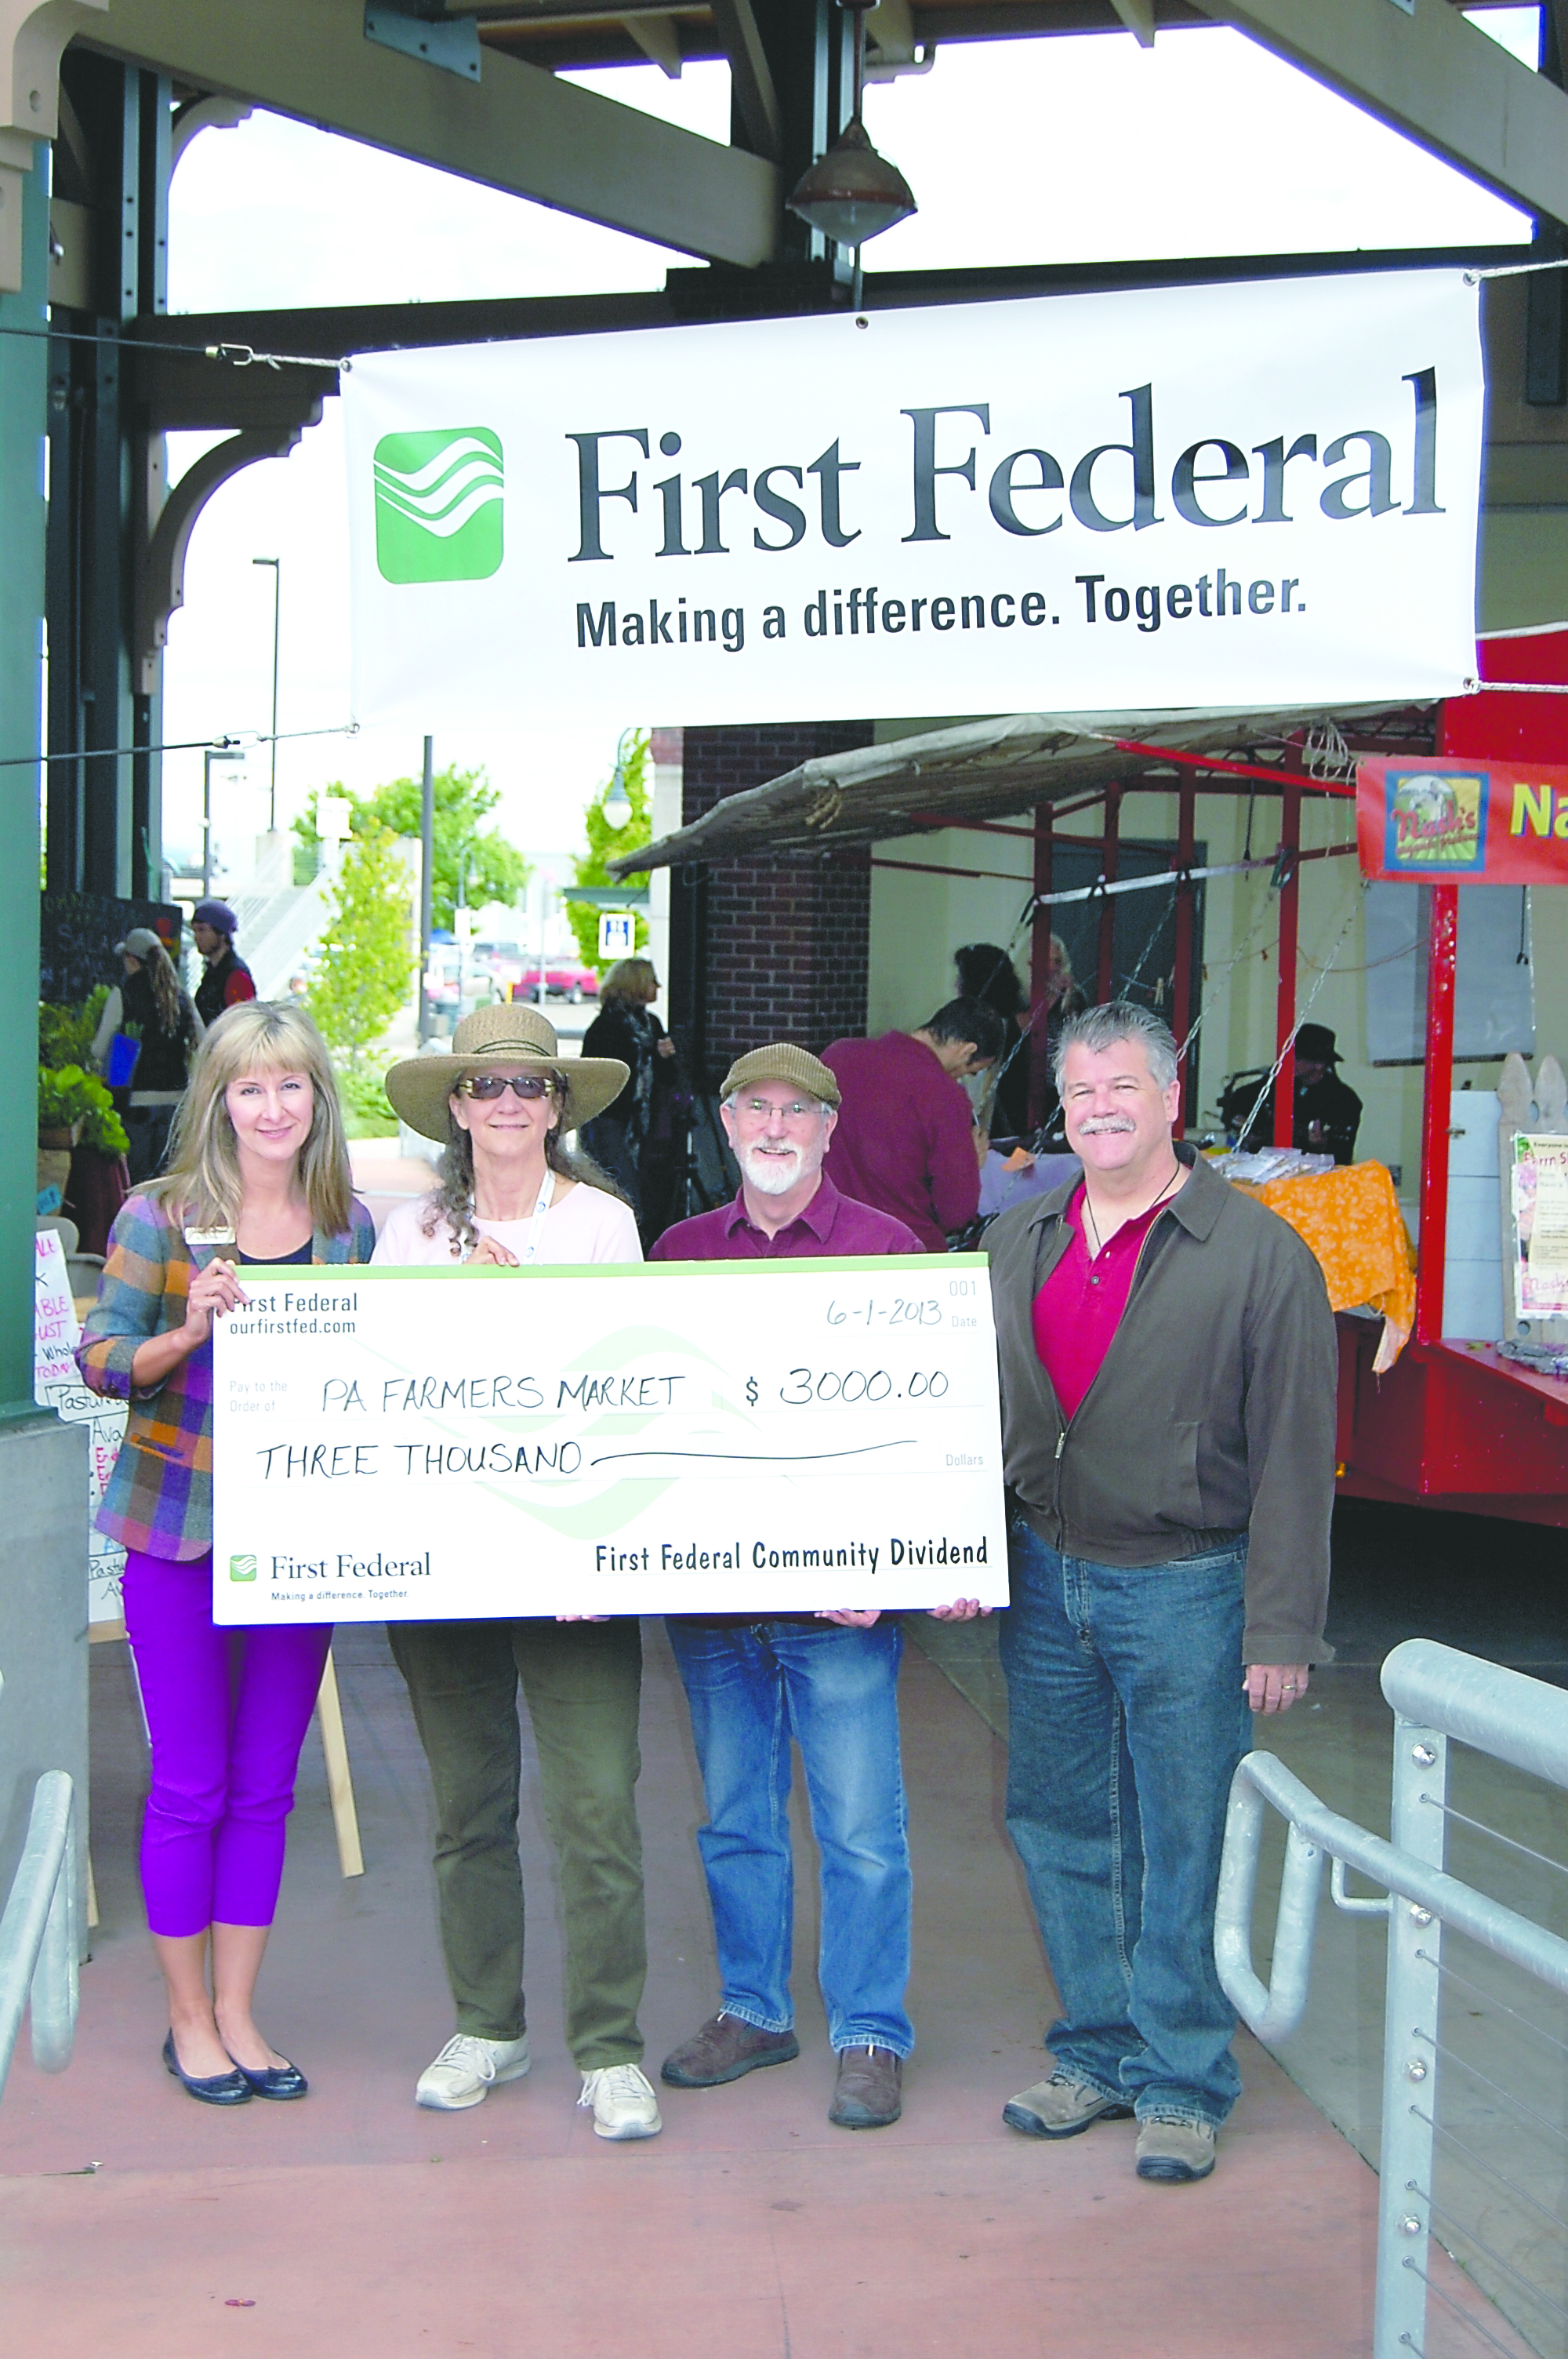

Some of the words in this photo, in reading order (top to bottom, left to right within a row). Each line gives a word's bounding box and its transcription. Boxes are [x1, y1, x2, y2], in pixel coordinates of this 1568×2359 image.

[565, 429, 862, 562] First
[900, 367, 1446, 543] Federal
[577, 598, 744, 652] Making
[763, 607, 785, 639] a
[804, 587, 1059, 637] difference.
[1076, 569, 1305, 632] Together.
[1524, 1151, 1555, 1166] Frm
[950, 1281, 975, 1296] 001
[234, 1294, 276, 1313] rst
[285, 1293, 357, 1312] Federal
[827, 1299, 942, 1325] 6-1-2013
[230, 1319, 355, 1335] ourfirstfed.com
[952, 1316, 976, 1327] Date
[230, 1381, 249, 1394] Pay
[270, 1381, 287, 1391] the
[323, 1379, 366, 1412] PA
[383, 1376, 543, 1412] FARMERS
[557, 1375, 685, 1411] MARKET
[746, 1376, 758, 1407] $
[780, 1369, 948, 1404] 3000.00
[230, 1401, 259, 1412] Order
[265, 1400, 274, 1411] of
[257, 1445, 378, 1480] THREE
[394, 1442, 581, 1476] THOUSAND
[946, 1454, 983, 1466] Dollars
[272, 1557, 326, 1579] First
[338, 1553, 430, 1578] Federal
[597, 1547, 648, 1572] First
[662, 1543, 739, 1571] Federal
[753, 1543, 879, 1575] Community
[891, 1537, 987, 1566] Dividend
[271, 1592, 306, 1602] Making
[317, 1590, 365, 1601] difference.
[368, 1589, 408, 1601] Together.
